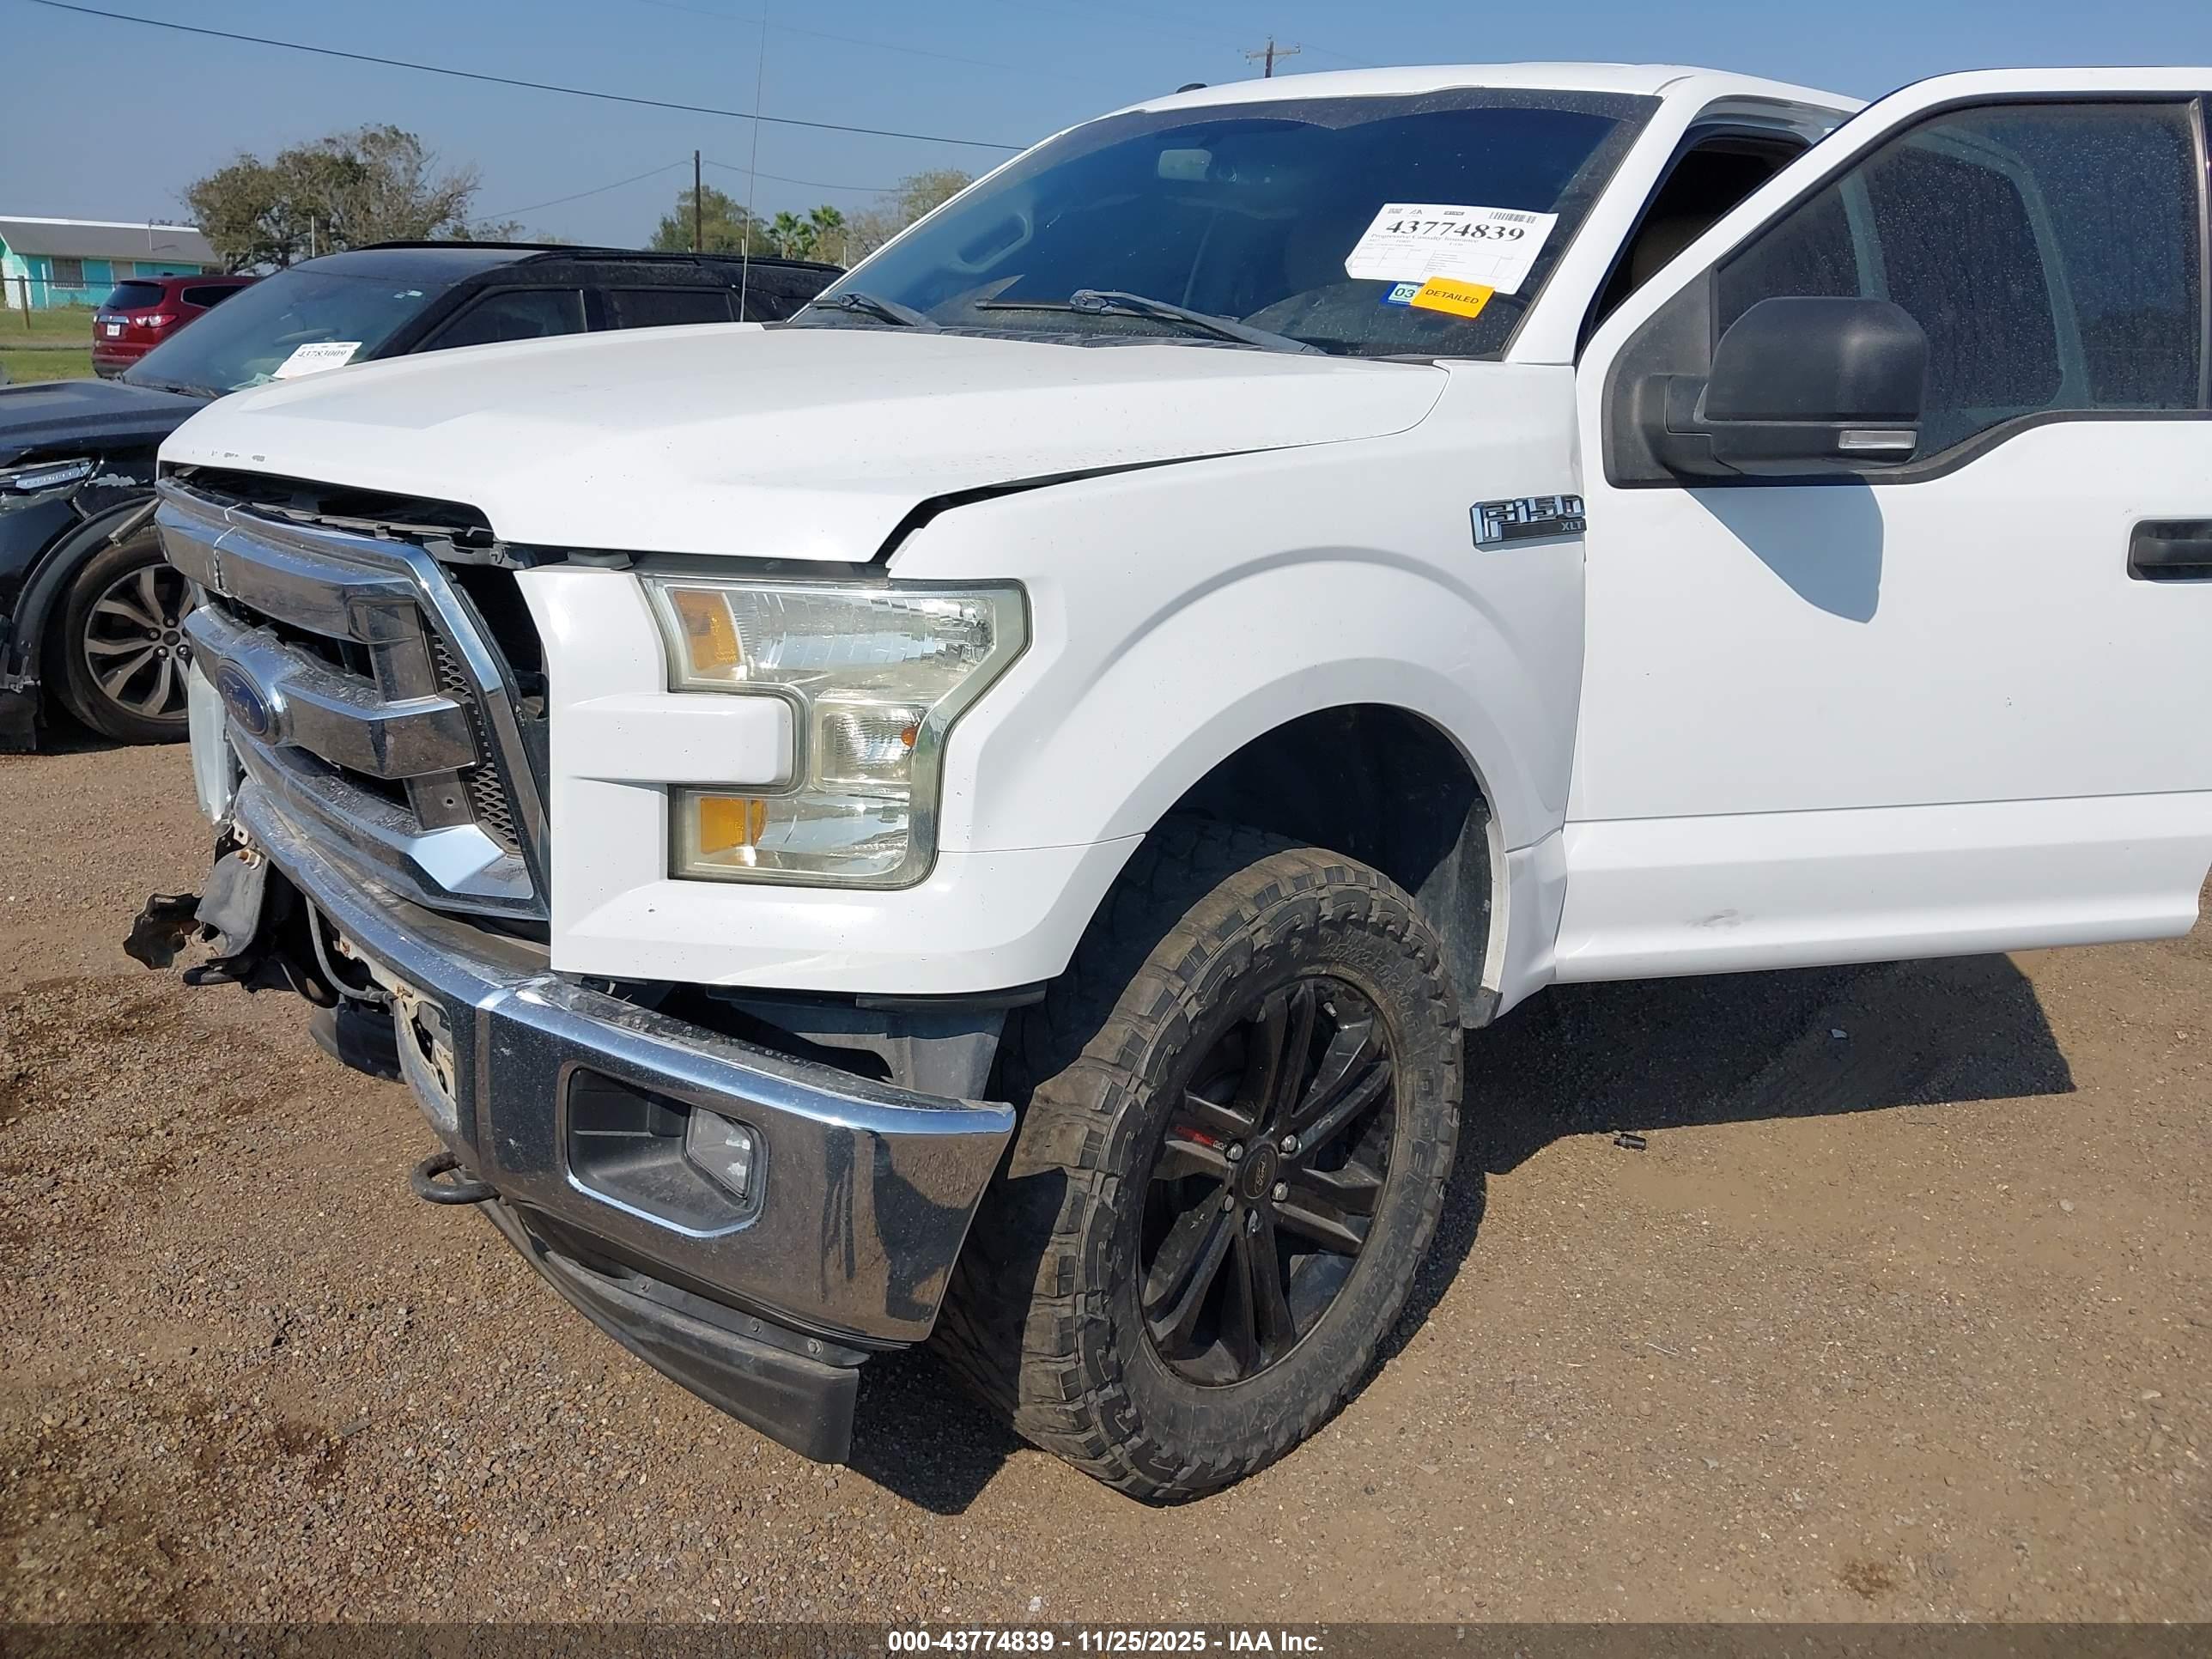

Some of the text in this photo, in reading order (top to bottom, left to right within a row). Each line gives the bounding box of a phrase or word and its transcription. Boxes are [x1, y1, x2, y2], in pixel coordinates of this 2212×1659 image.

[1386, 220, 1525, 242] 43774839
[1394, 288, 1416, 299] 03
[1425, 289, 1480, 304] DETAILED
[1561, 520, 1583, 531] XLT
